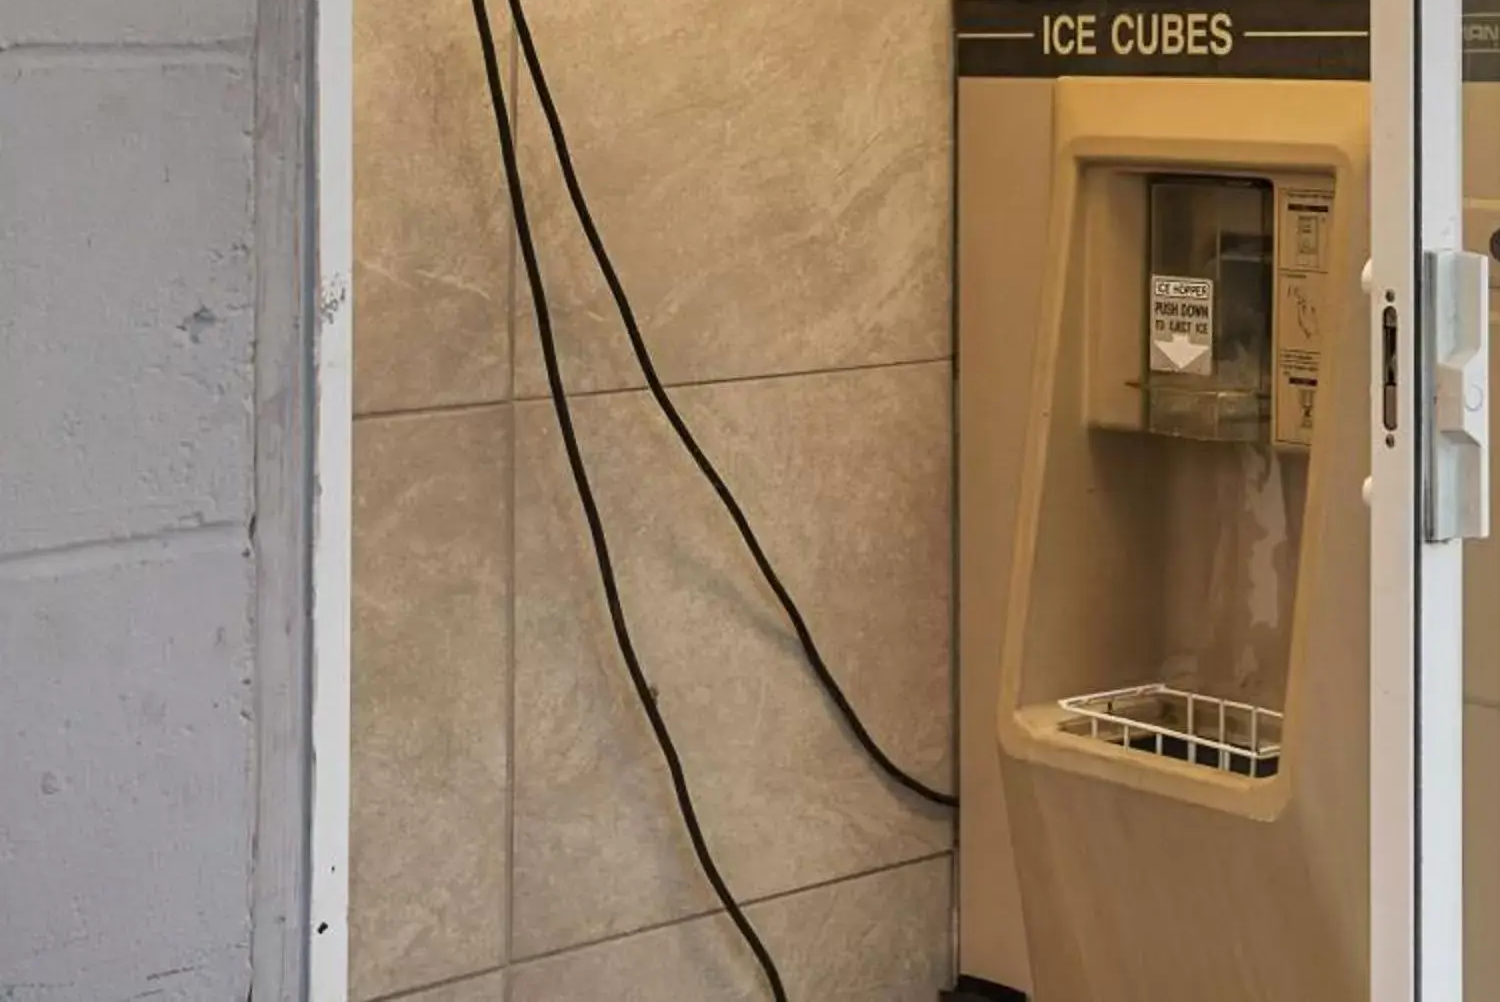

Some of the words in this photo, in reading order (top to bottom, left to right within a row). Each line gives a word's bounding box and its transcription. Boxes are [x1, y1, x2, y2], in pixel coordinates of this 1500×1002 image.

[1042, 14, 1097, 55] ICE
[1110, 12, 1234, 56] CUBES
[1155, 301, 1179, 316] PUSH
[1181, 303, 1209, 319] DOWN
